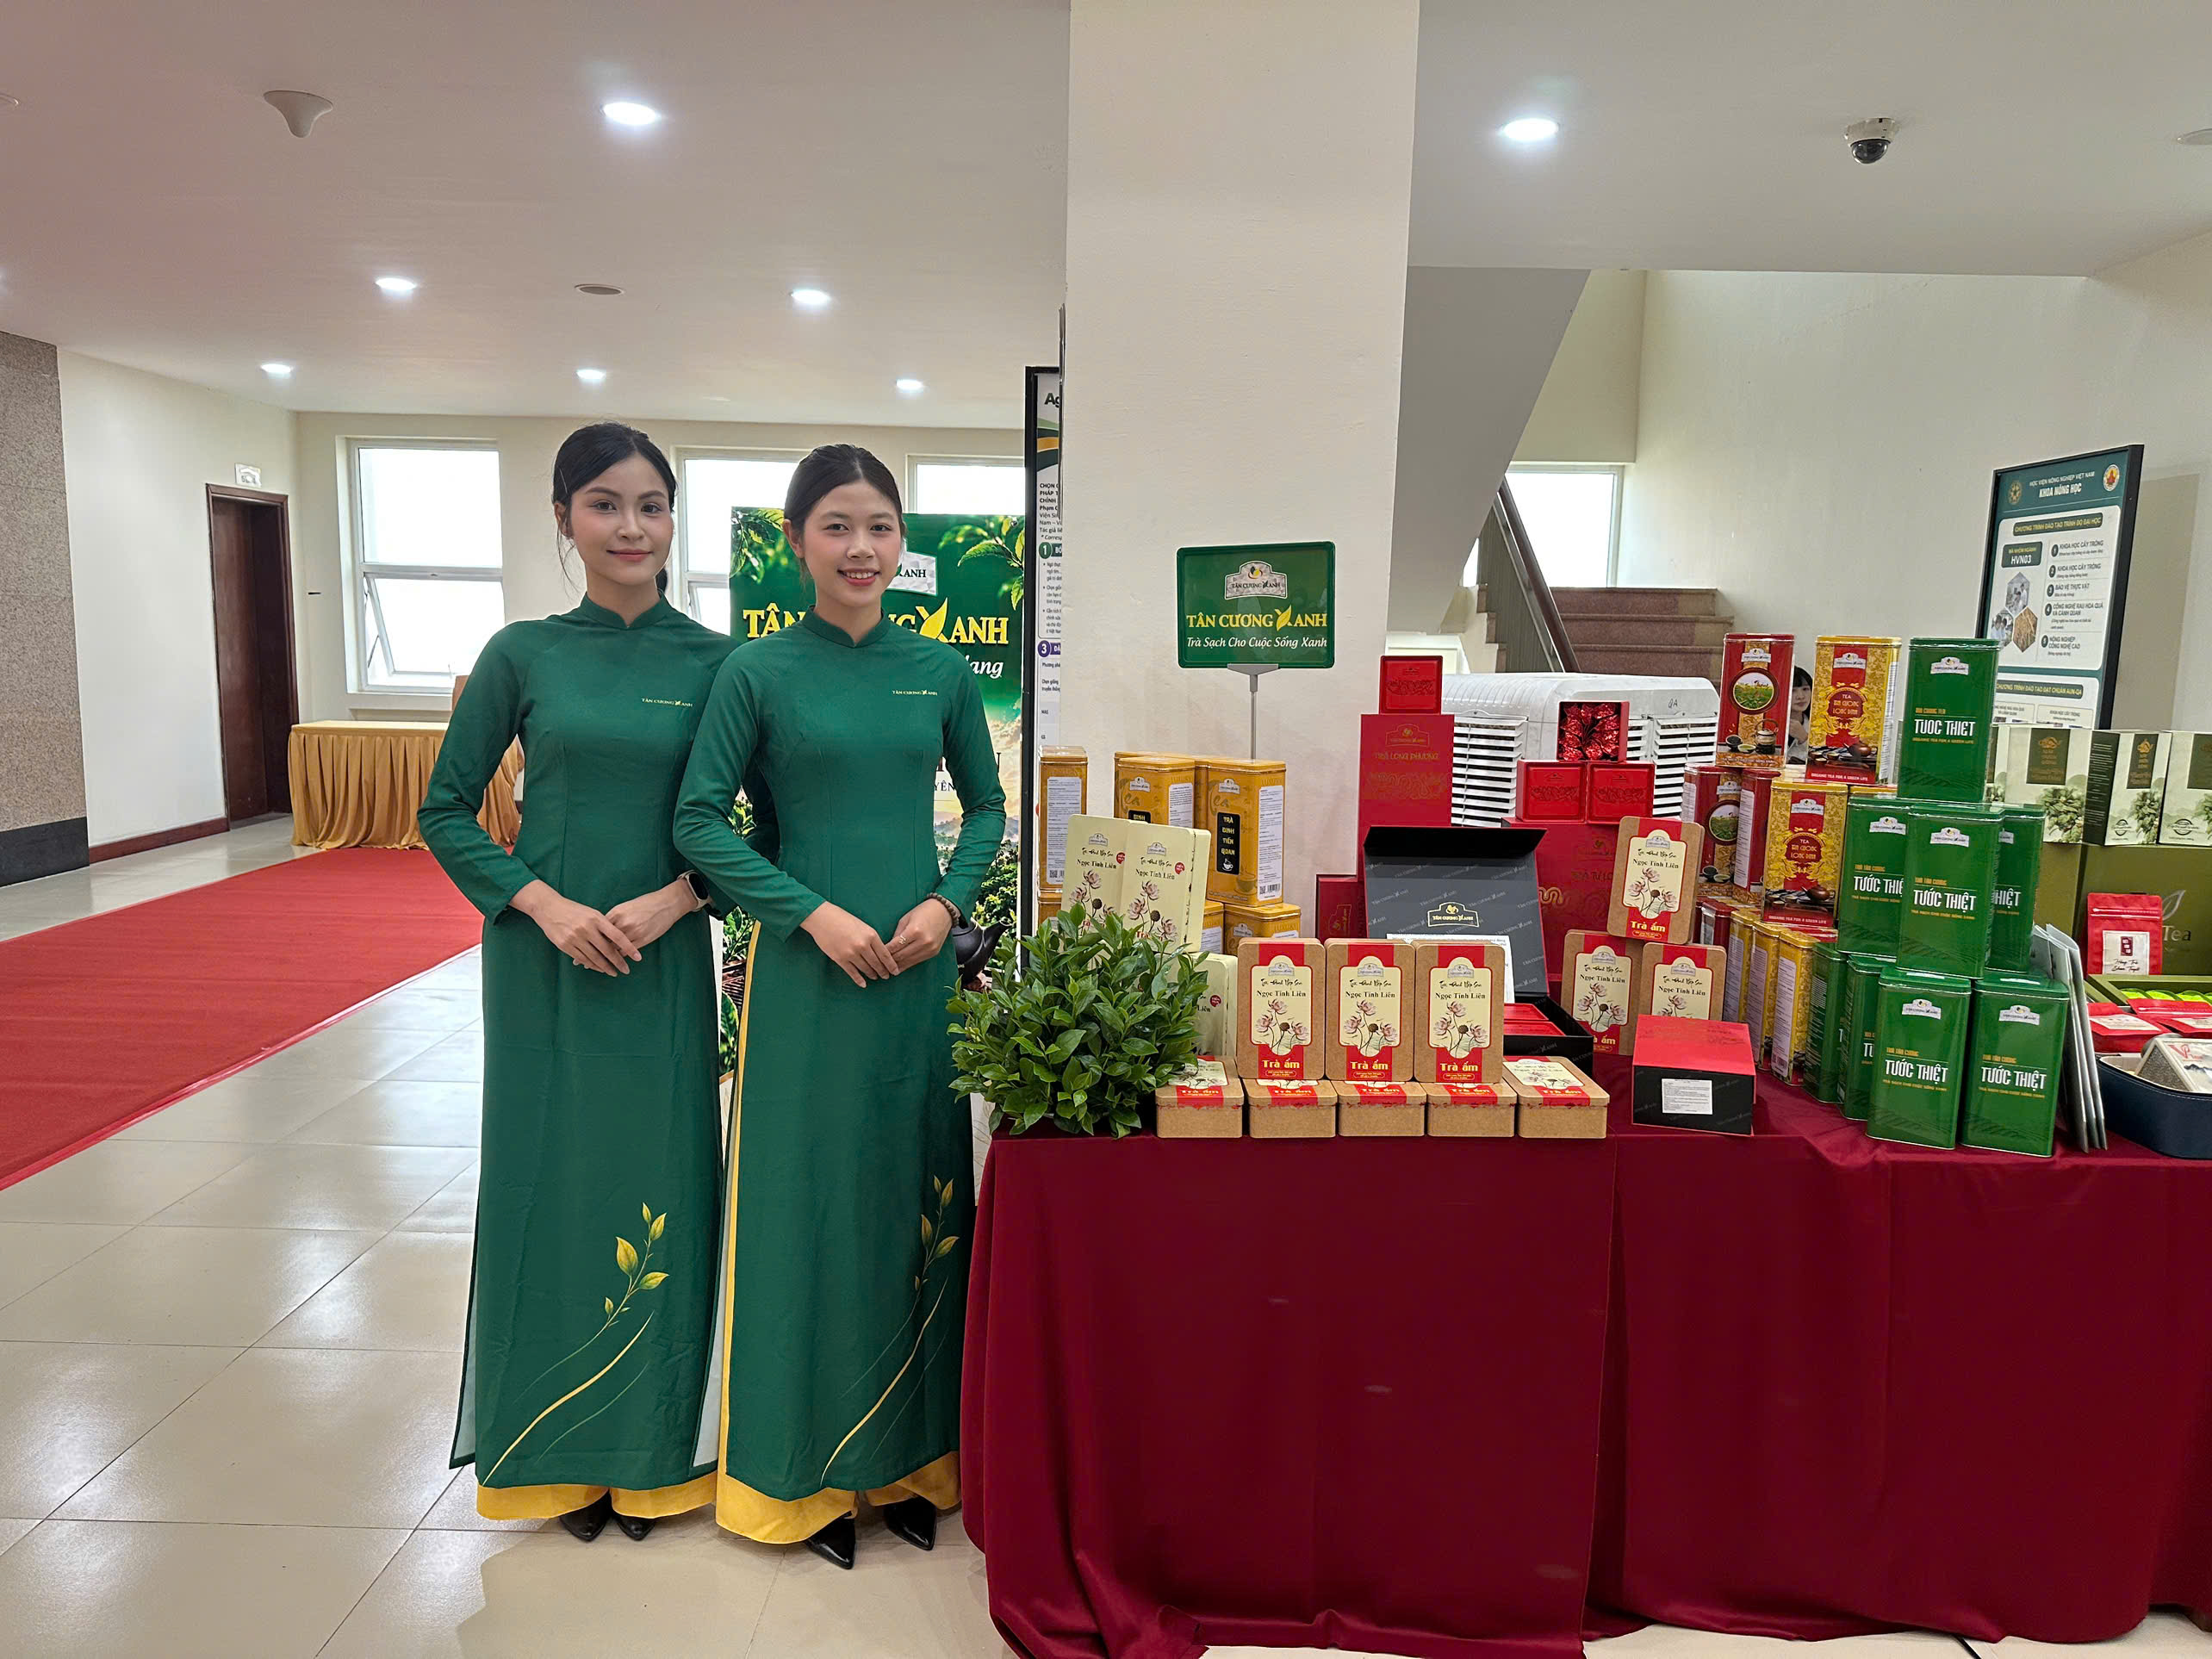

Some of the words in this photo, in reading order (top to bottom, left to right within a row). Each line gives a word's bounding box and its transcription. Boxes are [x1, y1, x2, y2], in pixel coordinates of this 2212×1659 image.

[2039, 487, 2054, 498] KHOA
[2054, 483, 2070, 496] NÔNG
[2070, 482, 2082, 494] HỌC
[2010, 554, 2032, 565] HVN03
[916, 597, 1009, 644] XANH
[1186, 612, 1215, 628] TÂN
[1219, 613, 1273, 628] CƯƠNG
[1275, 605, 1327, 631] XANH
[1187, 637, 1202, 648] Trà
[1203, 637, 1226, 649] Sạch
[1228, 637, 1246, 648] Cho
[1249, 637, 1271, 649] Cuộc
[1275, 636, 1298, 649] Sống
[1302, 637, 1327, 648] Xanh
[1914, 718, 1942, 736] TUOC
[1944, 720, 1976, 736] THIET
[1223, 816, 1233, 824] TRÀ
[1854, 874, 1881, 892] TƯỚC
[1883, 878, 1904, 898] THIỆ
[1913, 887, 1942, 907] TƯỚC
[1944, 892, 1977, 913] THIỆT
[1631, 921, 1648, 930] Trà
[1650, 922, 1666, 933] ấm
[2162, 925, 2191, 941] Tea
[1257, 990, 1273, 998] Ngọc
[1345, 991, 1362, 999] Ngọc
[1435, 992, 1451, 1001] Ngọc
[1601, 1035, 1616, 1045] ấm
[1262, 1059, 1280, 1069] Trà
[1283, 1058, 1300, 1069] ấm
[1351, 1060, 1369, 1070] Trà
[1372, 1059, 1389, 1070] ấm
[1440, 1062, 1458, 1072] Trà
[1462, 1059, 1478, 1072] ấm
[1885, 1059, 1914, 1078] TƯỚC
[1916, 1063, 1948, 1084] THIỆT
[1981, 1065, 2011, 1085] TƯỚC
[2013, 1070, 2047, 1091] THIỆT
